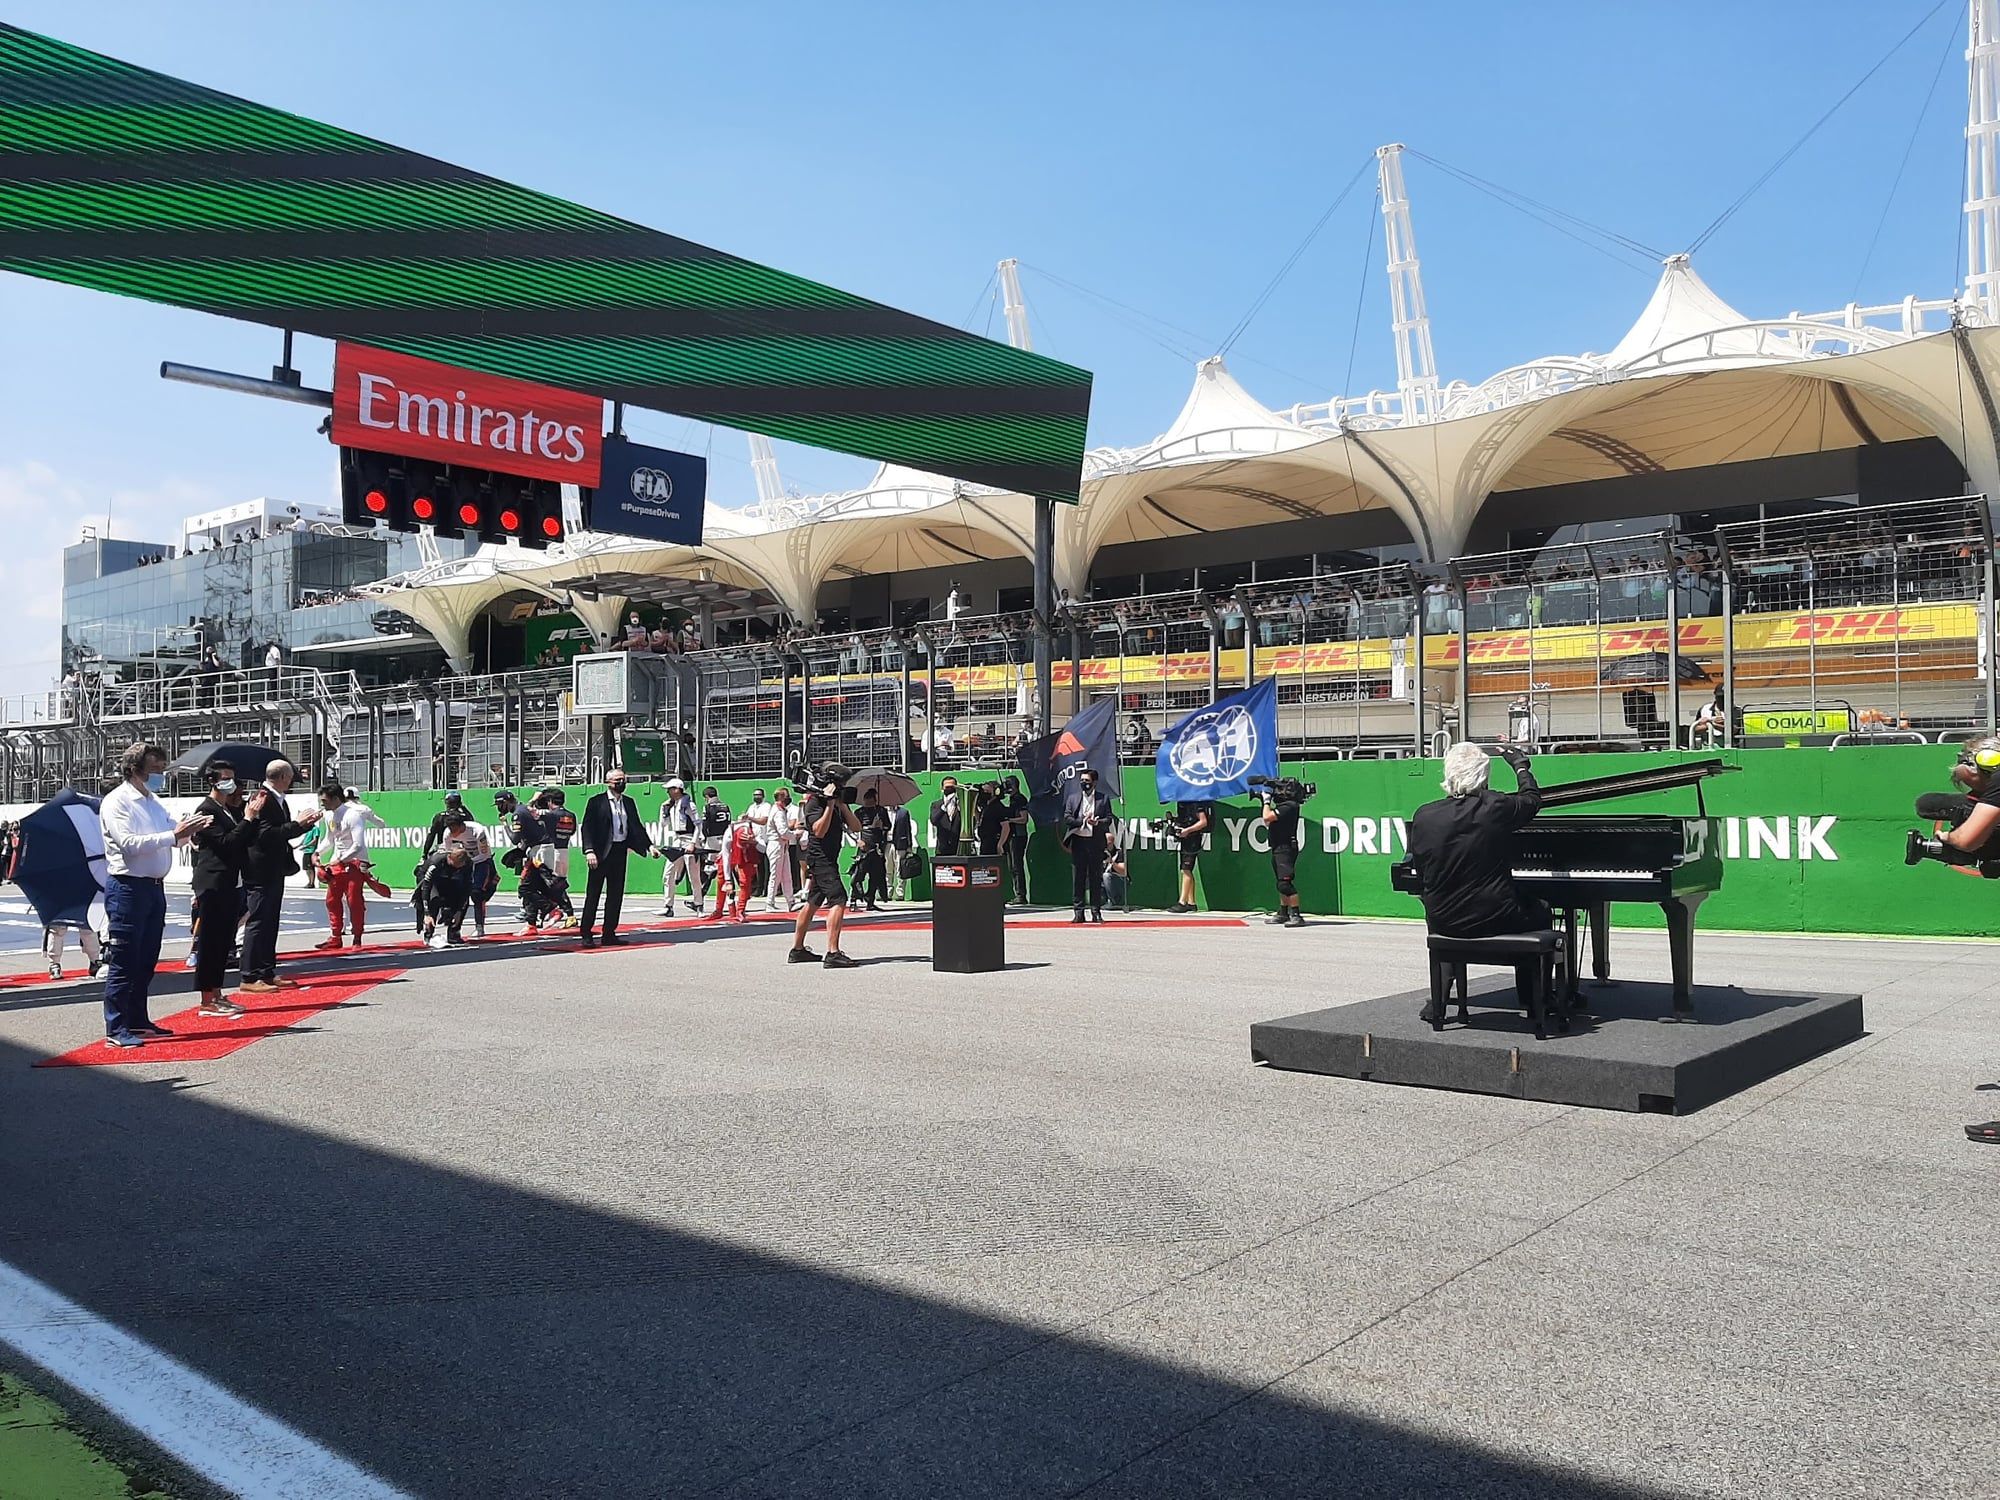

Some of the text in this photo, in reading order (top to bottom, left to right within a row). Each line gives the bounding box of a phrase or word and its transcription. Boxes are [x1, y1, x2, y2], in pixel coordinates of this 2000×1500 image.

[358, 372, 585, 463] Emirates
[621, 502, 680, 519] #PurposeDriven
[1790, 611, 1911, 640] DHL
[1605, 624, 1707, 650] DHL
[1443, 636, 1533, 660] DHL
[1271, 648, 1350, 669] DHL
[1052, 663, 1112, 682] DHL
[1299, 691, 1369, 703] VERSTAPPEN
[716, 811, 731, 822] 31
[364, 828, 400, 848] WHEN
